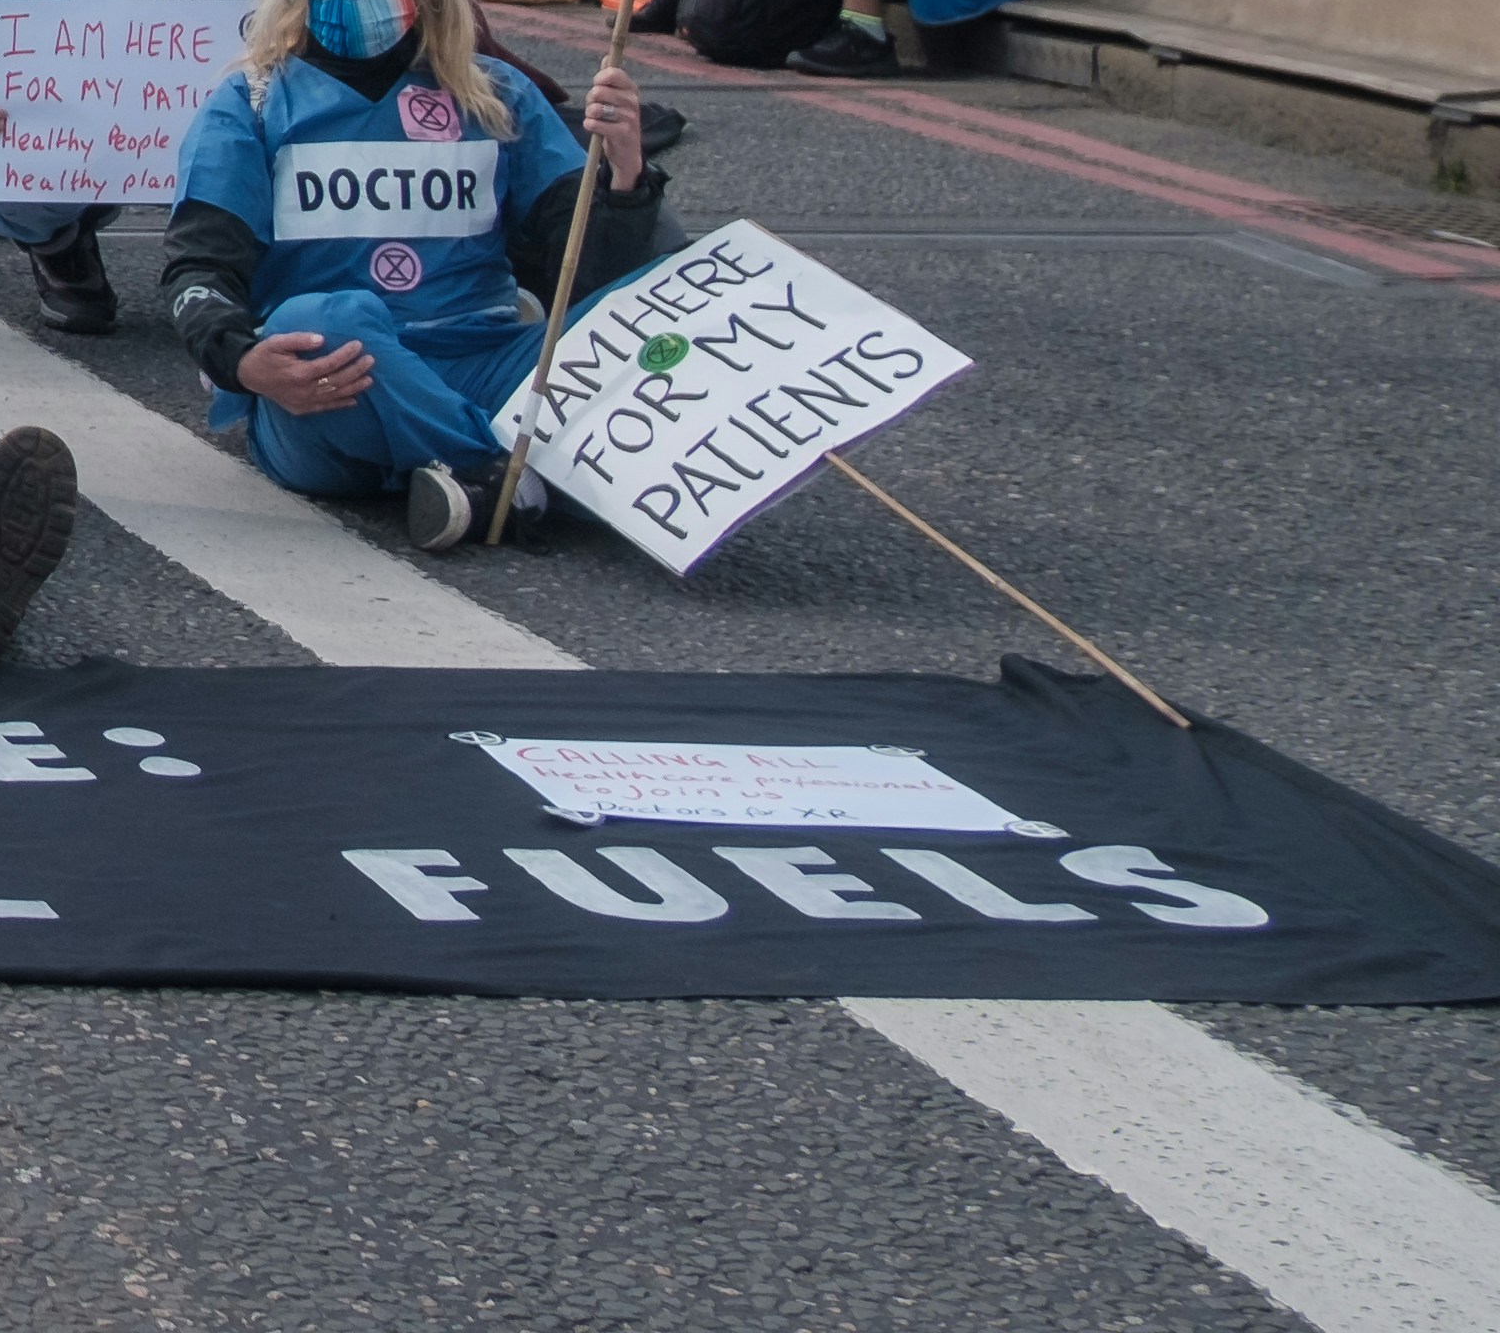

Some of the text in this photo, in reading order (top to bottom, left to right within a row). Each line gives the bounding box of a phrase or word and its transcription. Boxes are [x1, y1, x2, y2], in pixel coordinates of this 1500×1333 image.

[0, 13, 214, 63] I AM HERE
[5, 71, 123, 107] FOR MY
[1, 119, 94, 162] Healthy
[5, 162, 108, 200] healthy
[296, 167, 477, 212] DOCTOR
[542, 240, 774, 426] AM HERE
[573, 281, 827, 484] FOR MY
[631, 330, 924, 540] PATIENTS
[517, 746, 839, 769] CALLING ALL
[591, 801, 859, 820] Doctors XR
[341, 845, 1270, 929] FUELS
